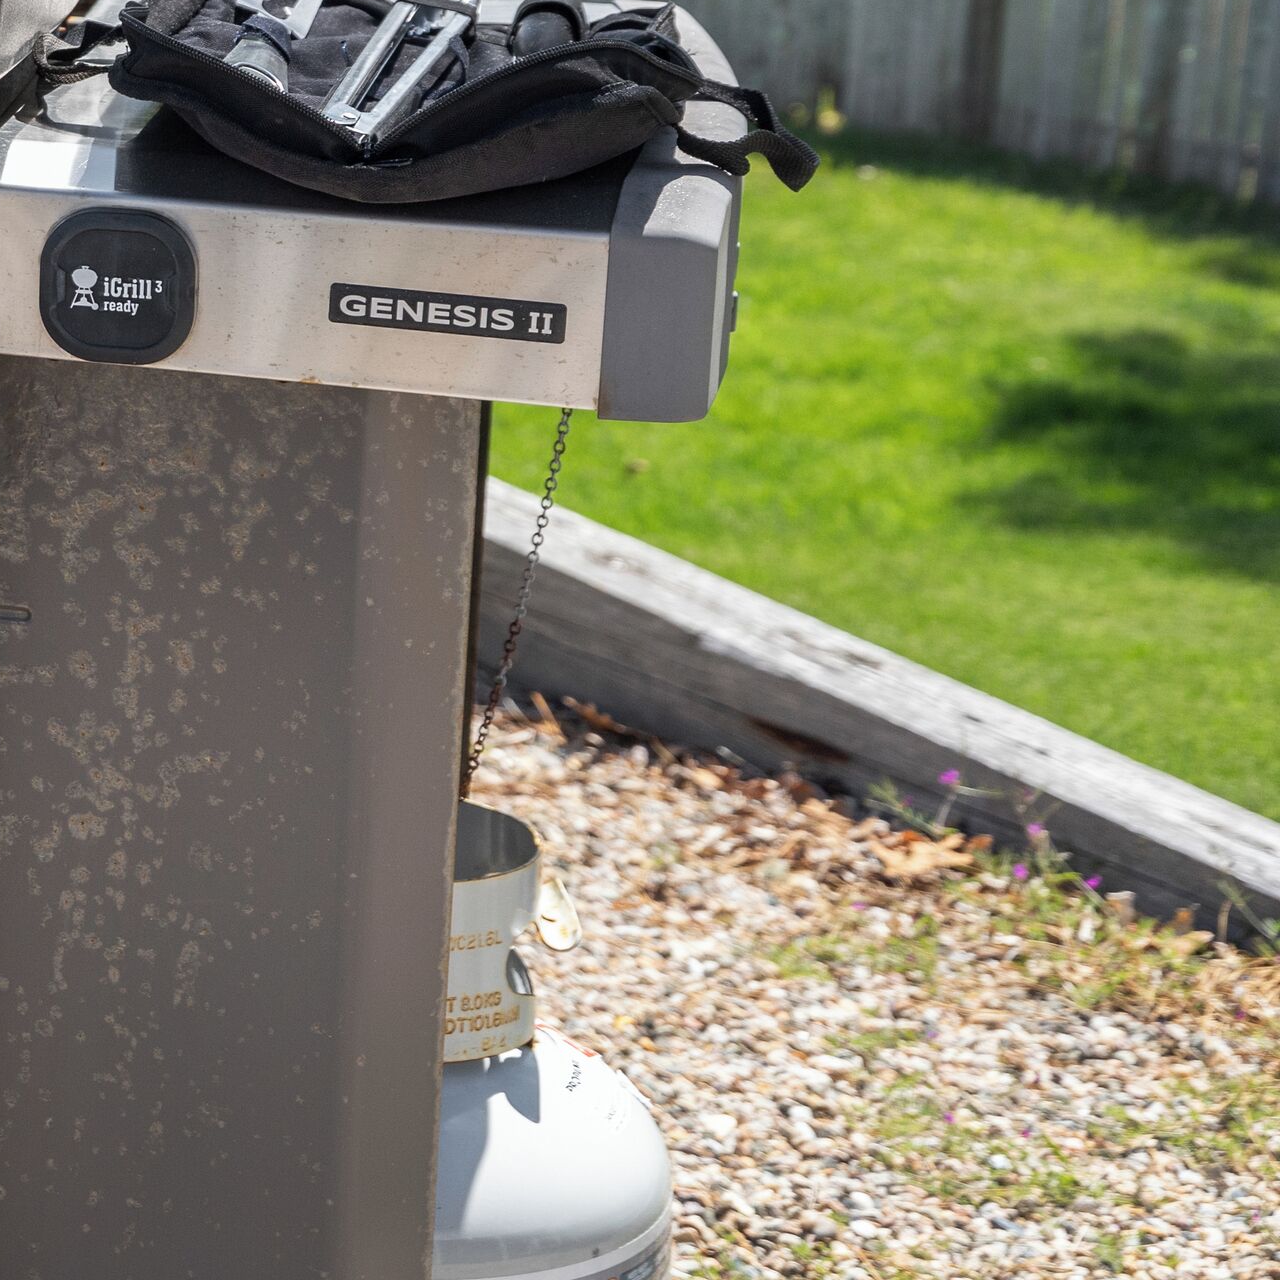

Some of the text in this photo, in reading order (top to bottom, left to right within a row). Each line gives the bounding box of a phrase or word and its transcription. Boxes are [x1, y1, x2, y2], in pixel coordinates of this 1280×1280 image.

[103, 300, 139, 316] ready
[339, 294, 554, 335] GENESIS II
